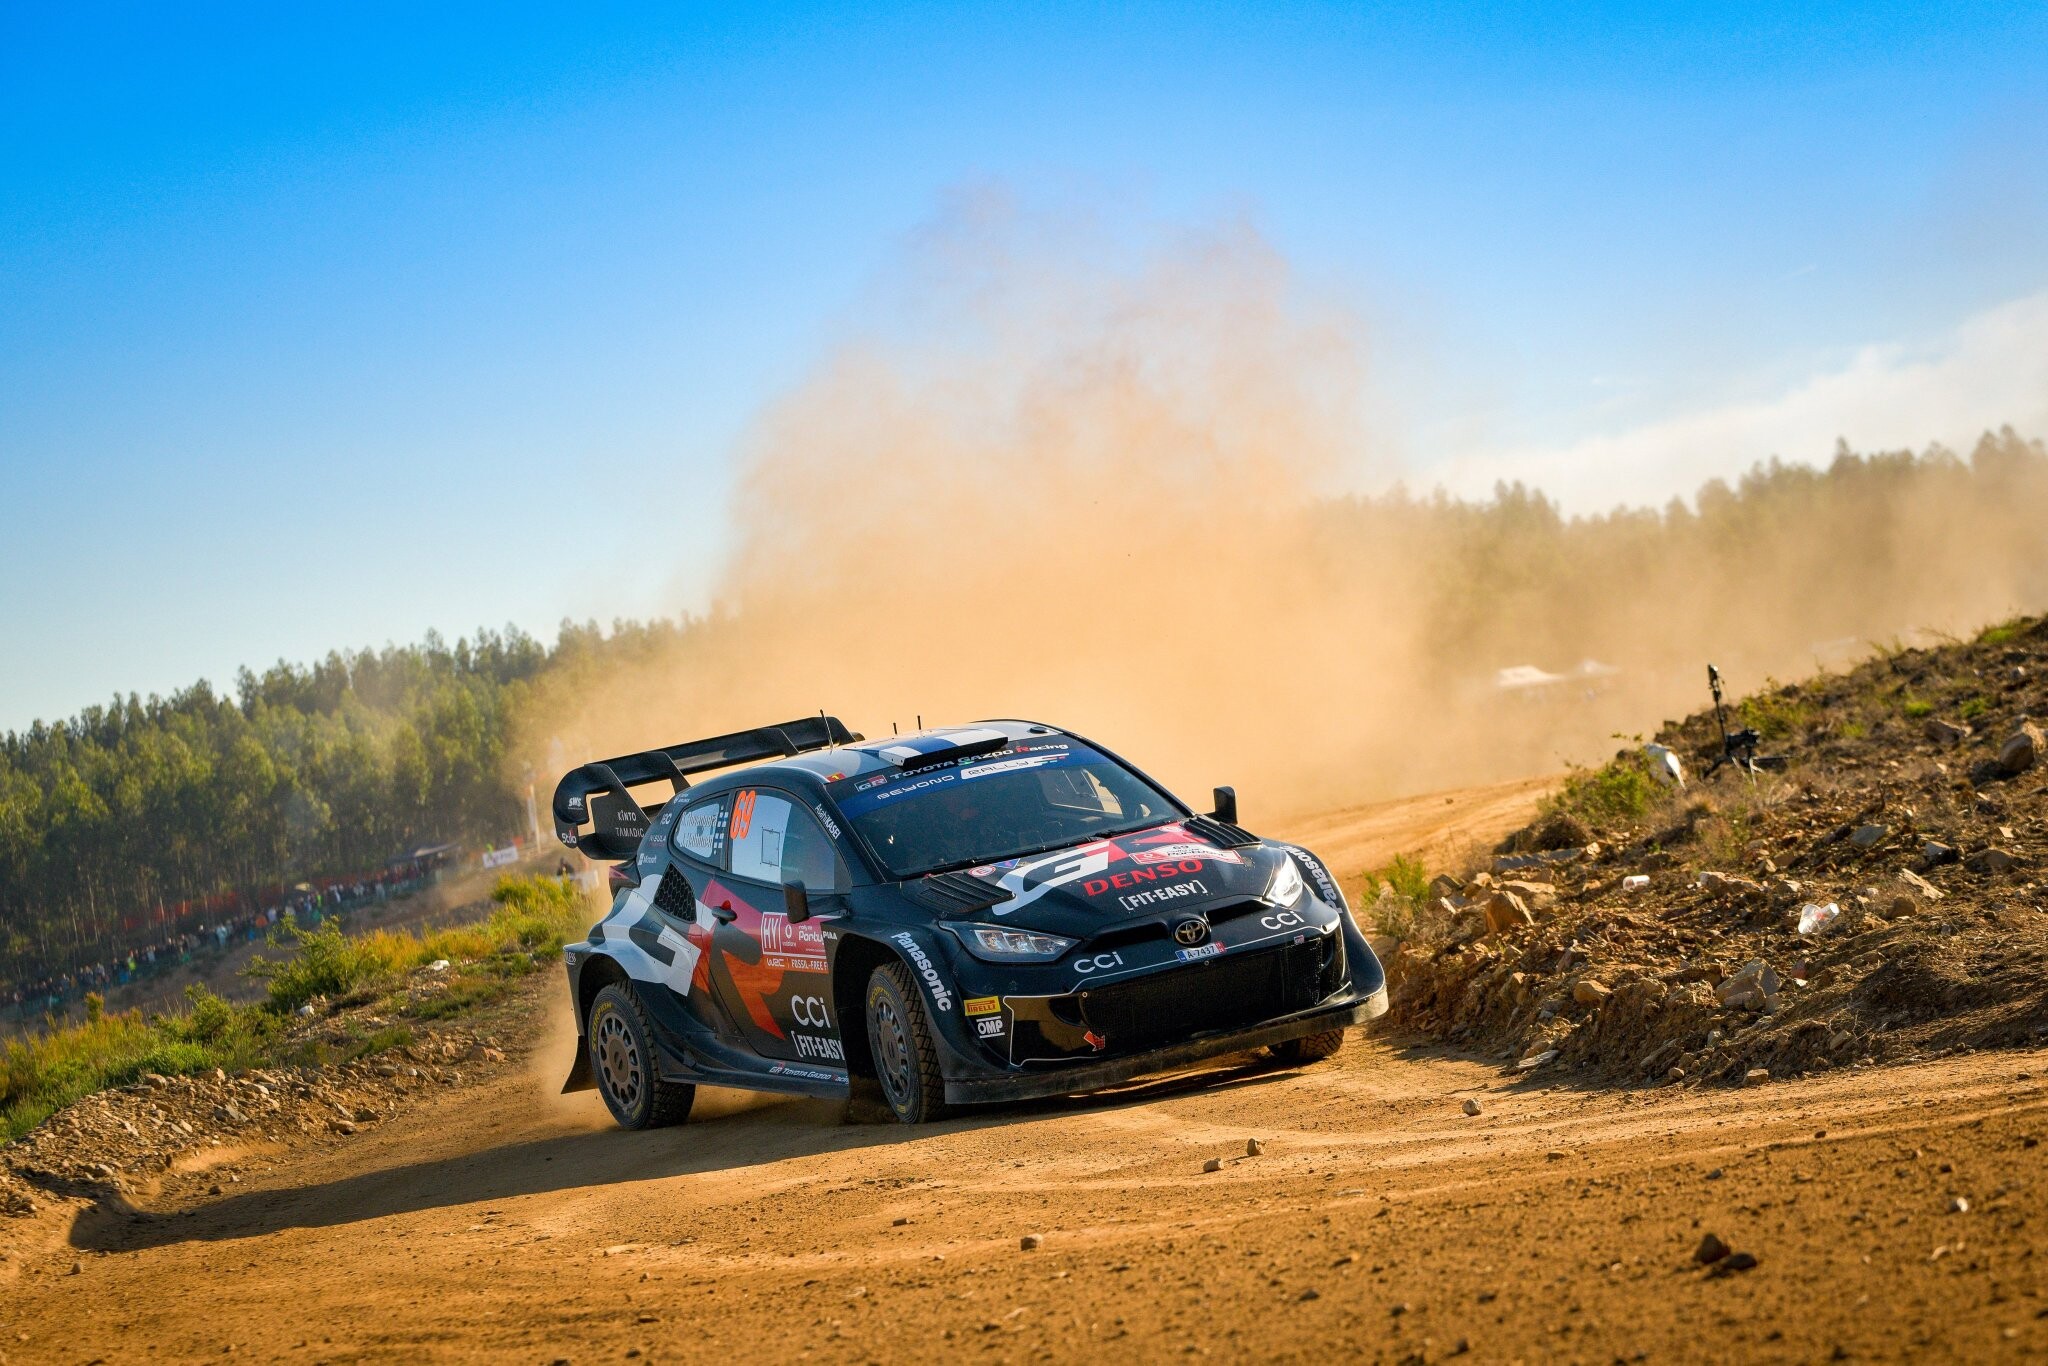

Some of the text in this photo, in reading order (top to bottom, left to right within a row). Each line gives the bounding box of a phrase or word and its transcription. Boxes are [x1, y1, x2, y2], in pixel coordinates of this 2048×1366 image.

[889, 760, 955, 780] TOYOTA
[957, 749, 1014, 764] GAZOO
[1016, 743, 1069, 754] Racing
[876, 759, 1030, 800] BEYOND RALLY
[730, 790, 756, 839] 69
[1083, 859, 1203, 897] DENSO
[791, 959, 823, 970] FOSSIL-FREE
[1187, 945, 1215, 959] A-7437
[890, 931, 952, 1012] Panasonic
[966, 999, 996, 1014] PIRELLI
[977, 1019, 1003, 1035] OMP
[782, 1068, 808, 1077] TOYOTA
[807, 1071, 831, 1080] GAZOO
